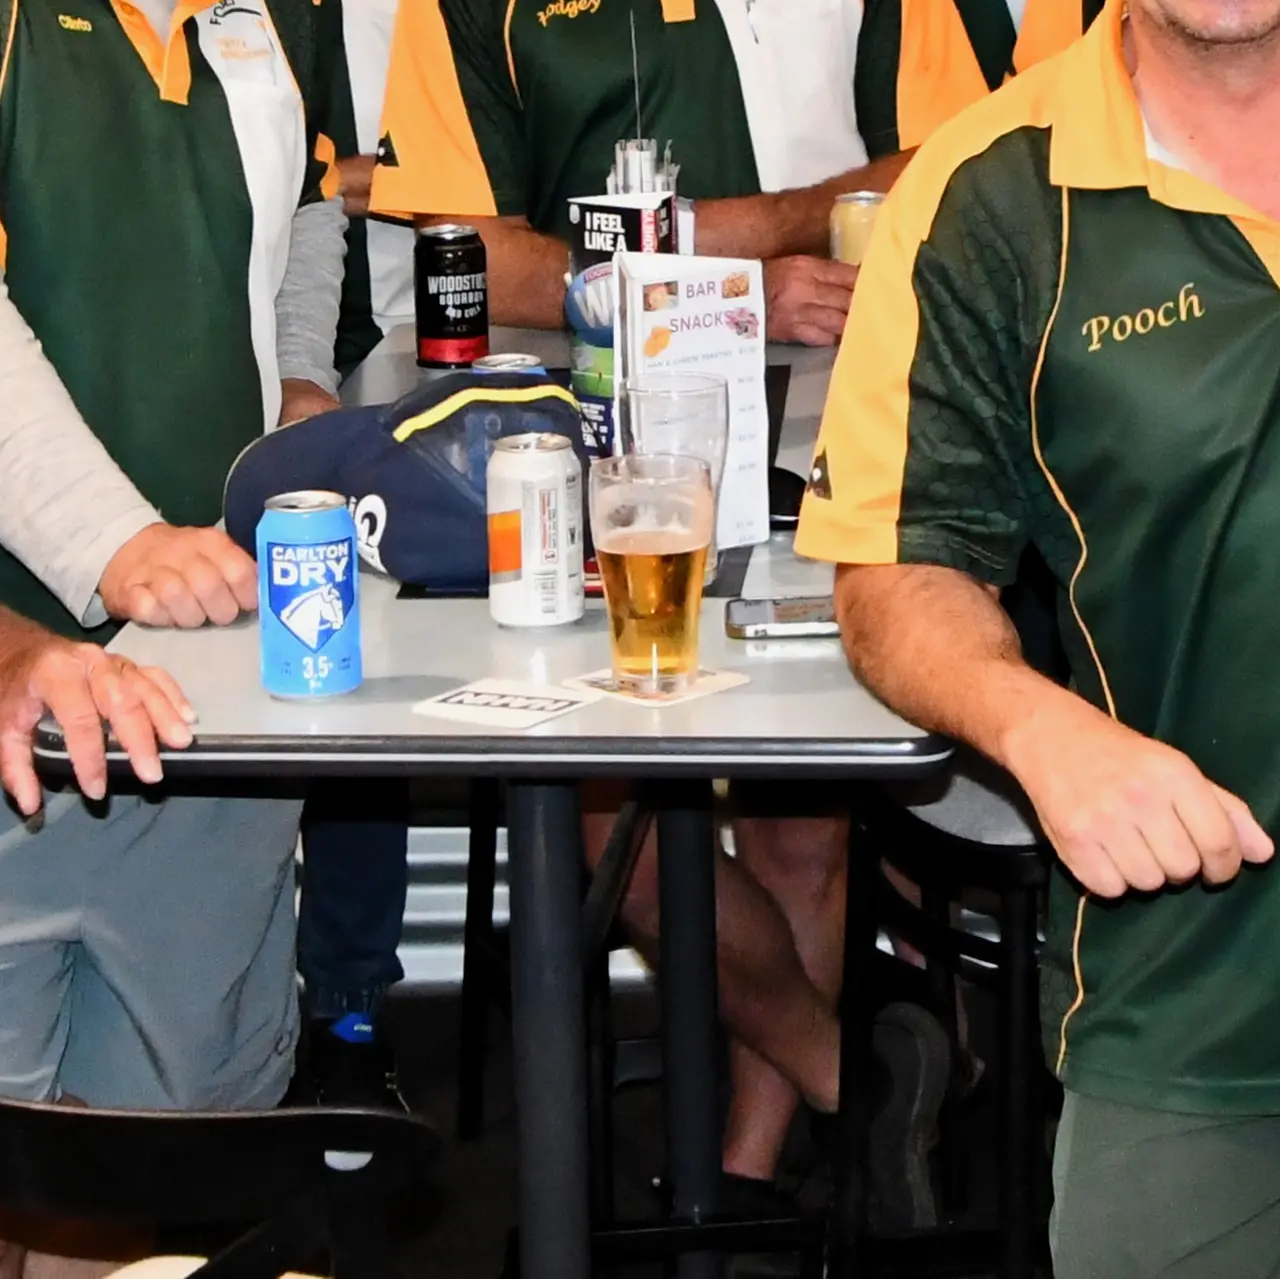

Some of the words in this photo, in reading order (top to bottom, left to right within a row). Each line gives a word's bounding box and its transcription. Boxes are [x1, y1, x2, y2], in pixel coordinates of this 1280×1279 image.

[585, 211, 591, 230] I
[592, 212, 625, 234] FEEL
[584, 230, 615, 252] LIKE
[616, 234, 627, 252] A
[686, 281, 716, 299] BAR
[1081, 282, 1206, 352] Pooch
[272, 541, 348, 561] CARLTON
[272, 556, 348, 587] DRY
